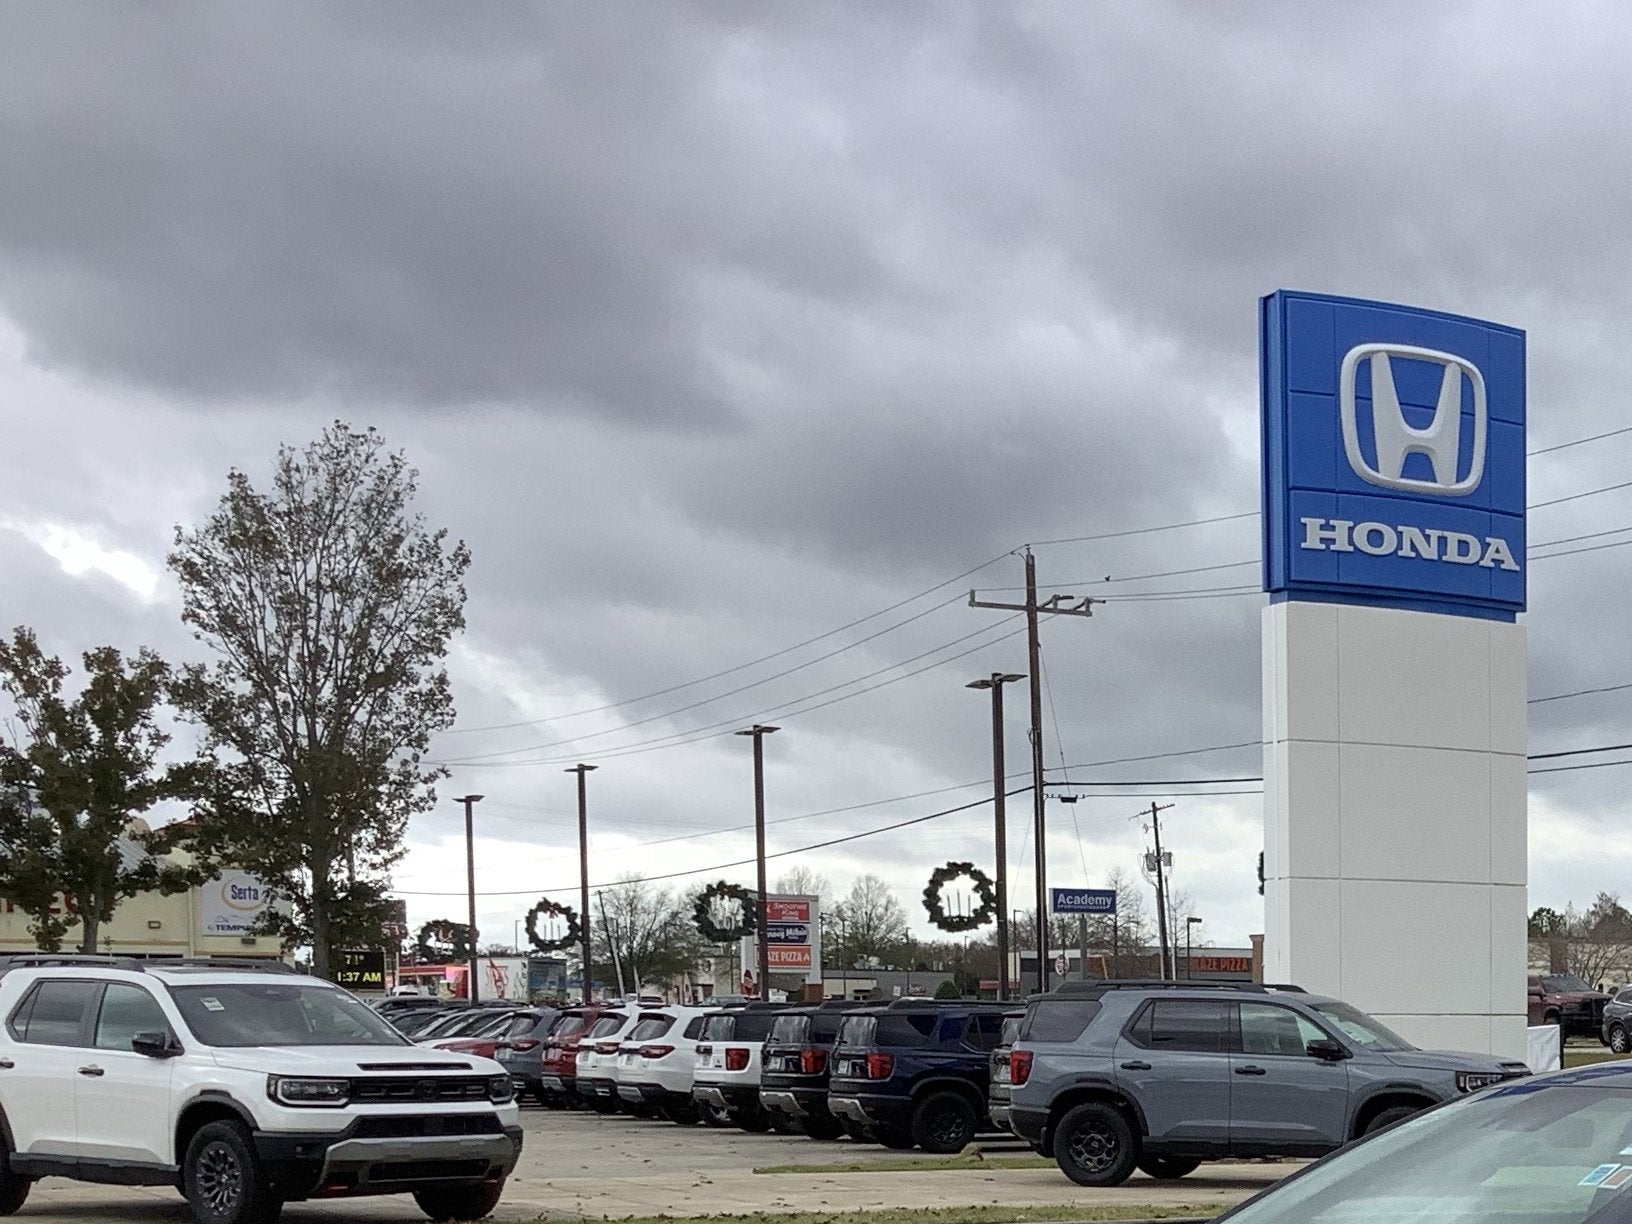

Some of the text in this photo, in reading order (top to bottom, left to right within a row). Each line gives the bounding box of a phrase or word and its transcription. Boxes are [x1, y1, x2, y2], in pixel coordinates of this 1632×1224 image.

[1300, 517, 1521, 572] HONDA
[231, 884, 259, 901] Serta
[1057, 893, 1113, 909] Academy
[780, 952, 803, 962] PIZZA
[1220, 958, 1249, 971] PIZZA
[362, 971, 381, 982] AM
